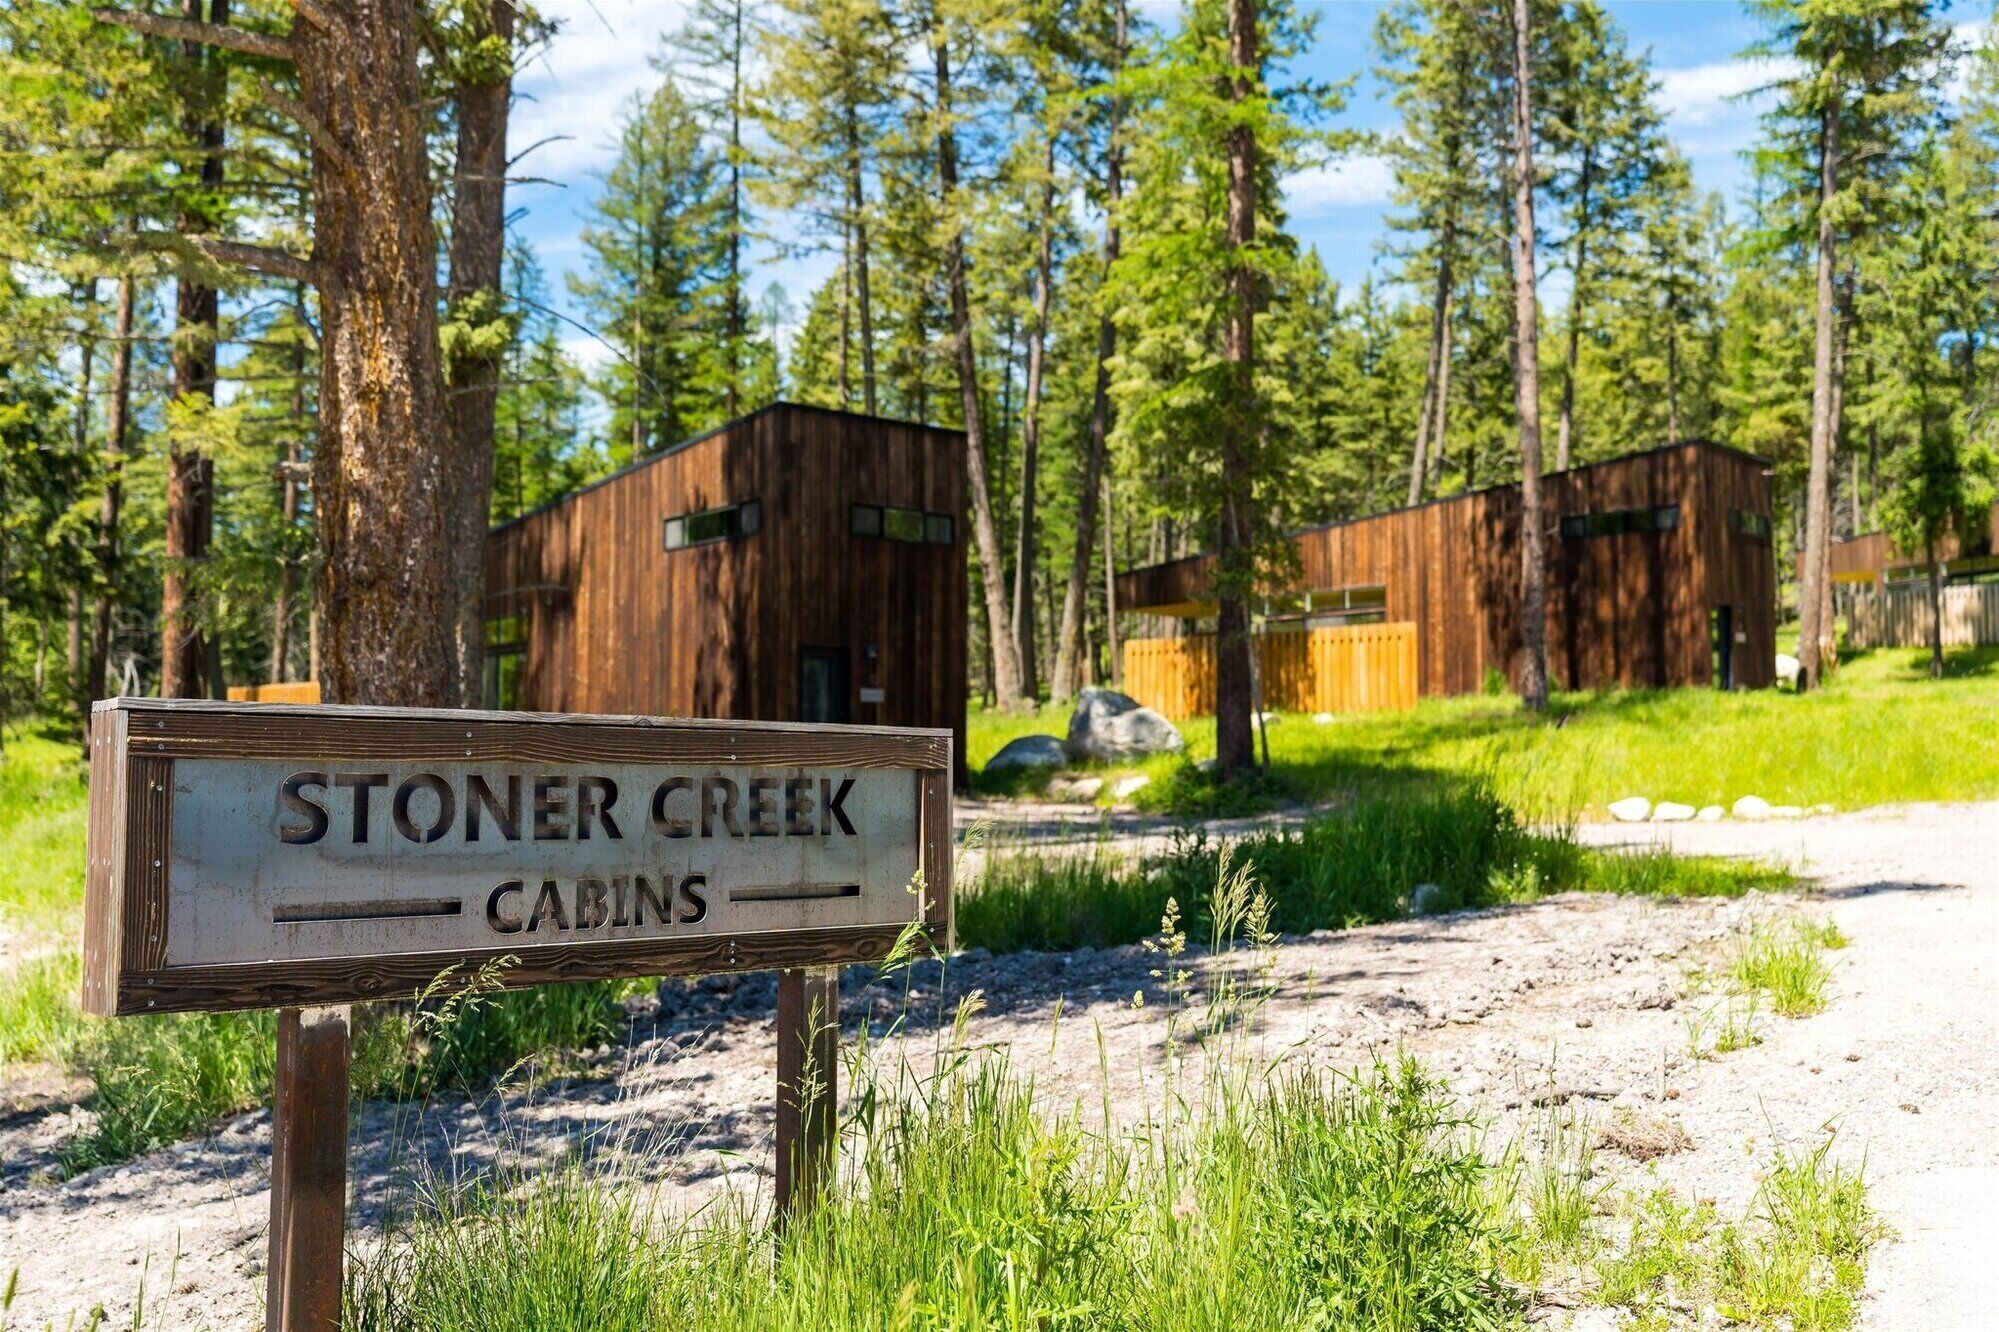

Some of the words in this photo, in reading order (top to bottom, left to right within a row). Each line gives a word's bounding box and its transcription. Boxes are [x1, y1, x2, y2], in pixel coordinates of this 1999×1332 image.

[279, 771, 622, 844] STONER
[651, 774, 857, 838] CREEK
[486, 874, 708, 935] CABINS
